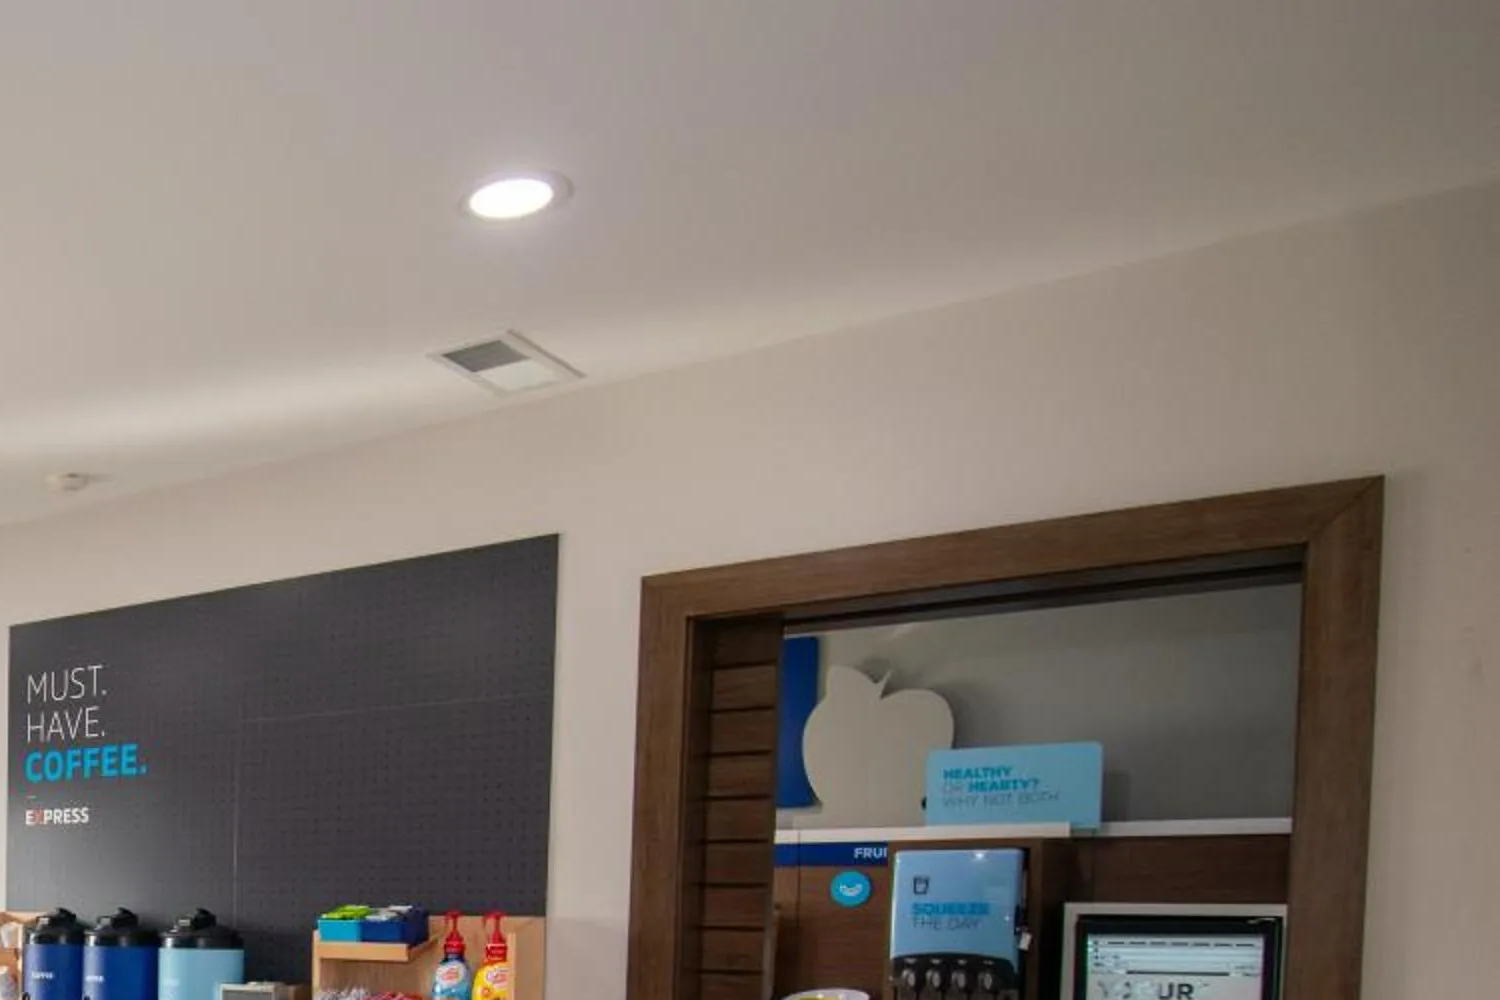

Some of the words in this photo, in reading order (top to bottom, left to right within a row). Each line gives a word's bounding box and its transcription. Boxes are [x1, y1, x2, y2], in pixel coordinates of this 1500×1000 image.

[27, 664, 107, 704] MUST.
[27, 706, 105, 743] HAVE.
[24, 743, 147, 782] COFFEE.
[943, 765, 1012, 780] HEALTHY
[968, 777, 1040, 793] HEARTY?
[25, 807, 89, 825] EXPRESS
[912, 902, 990, 916] SQUEEZE
[913, 917, 939, 930] THE
[949, 917, 981, 930] DAY
